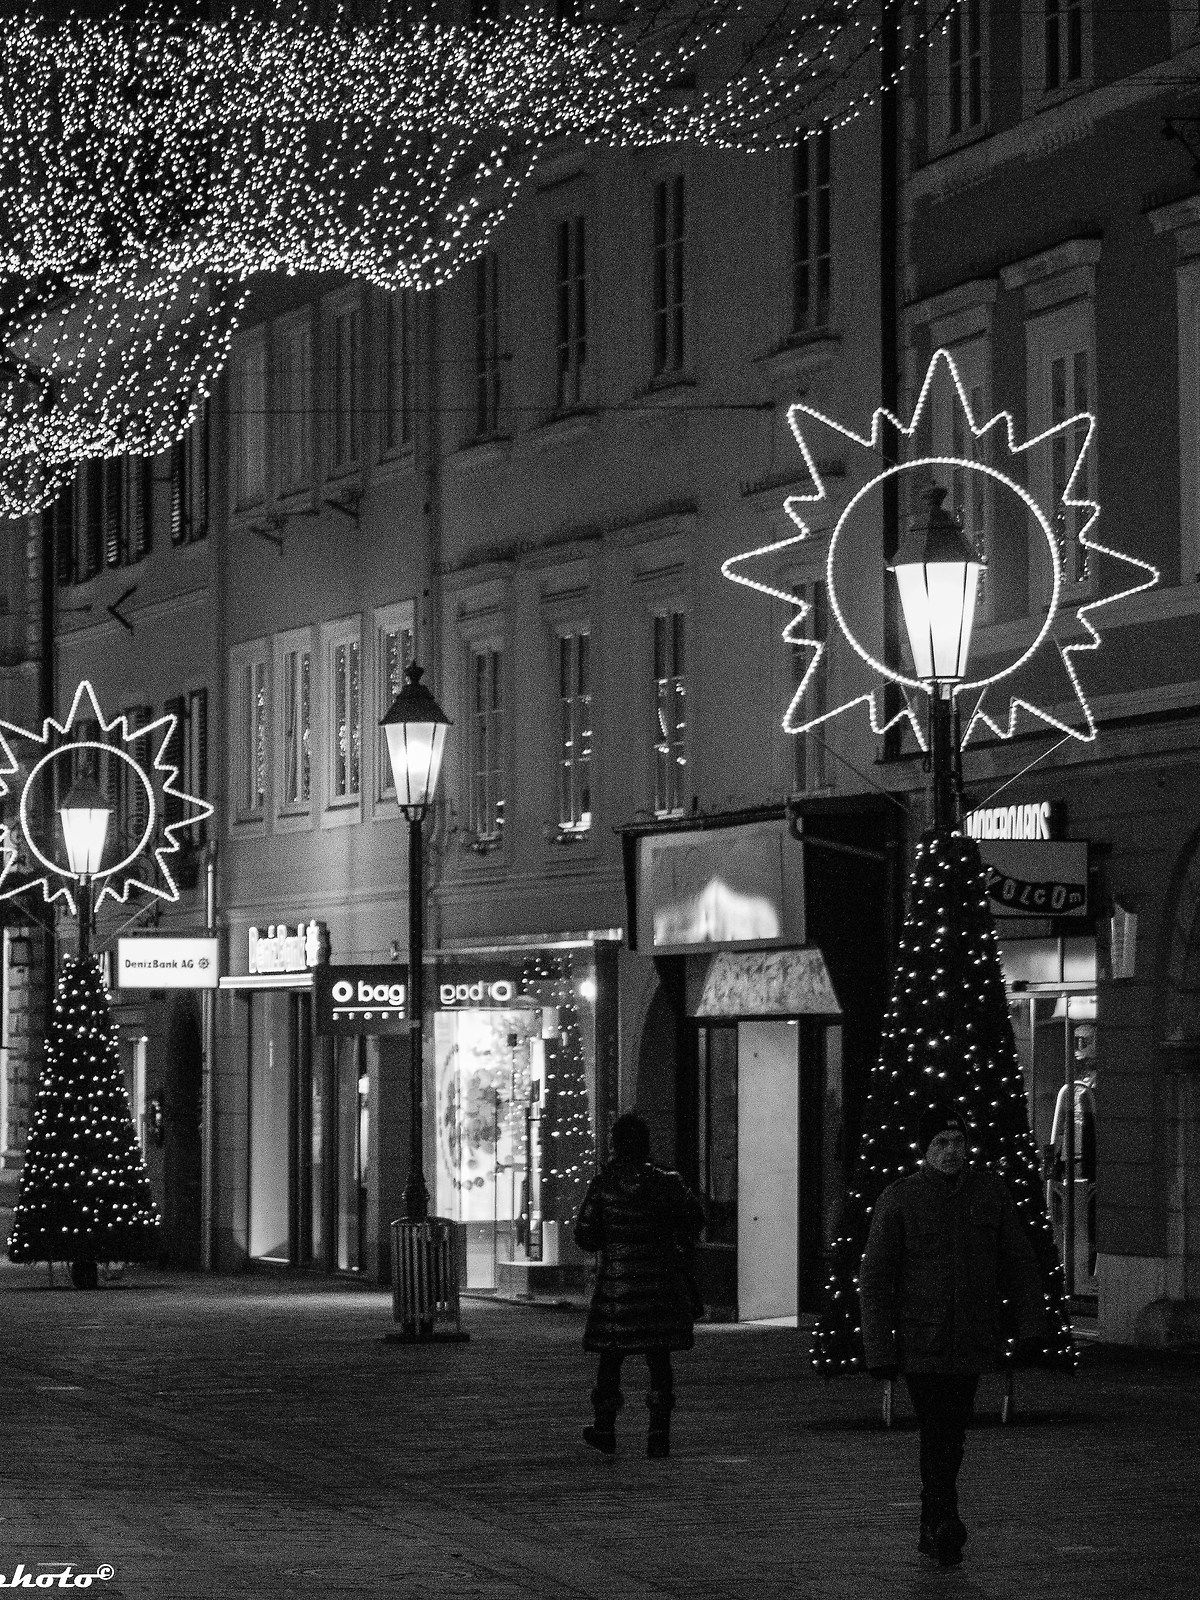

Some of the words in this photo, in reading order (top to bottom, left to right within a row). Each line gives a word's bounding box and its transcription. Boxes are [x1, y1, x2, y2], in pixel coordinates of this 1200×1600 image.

[125, 959, 178, 969] DenizBank
[181, 959, 194, 969] AG
[332, 981, 353, 1002] O
[358, 980, 405, 1005] bag
